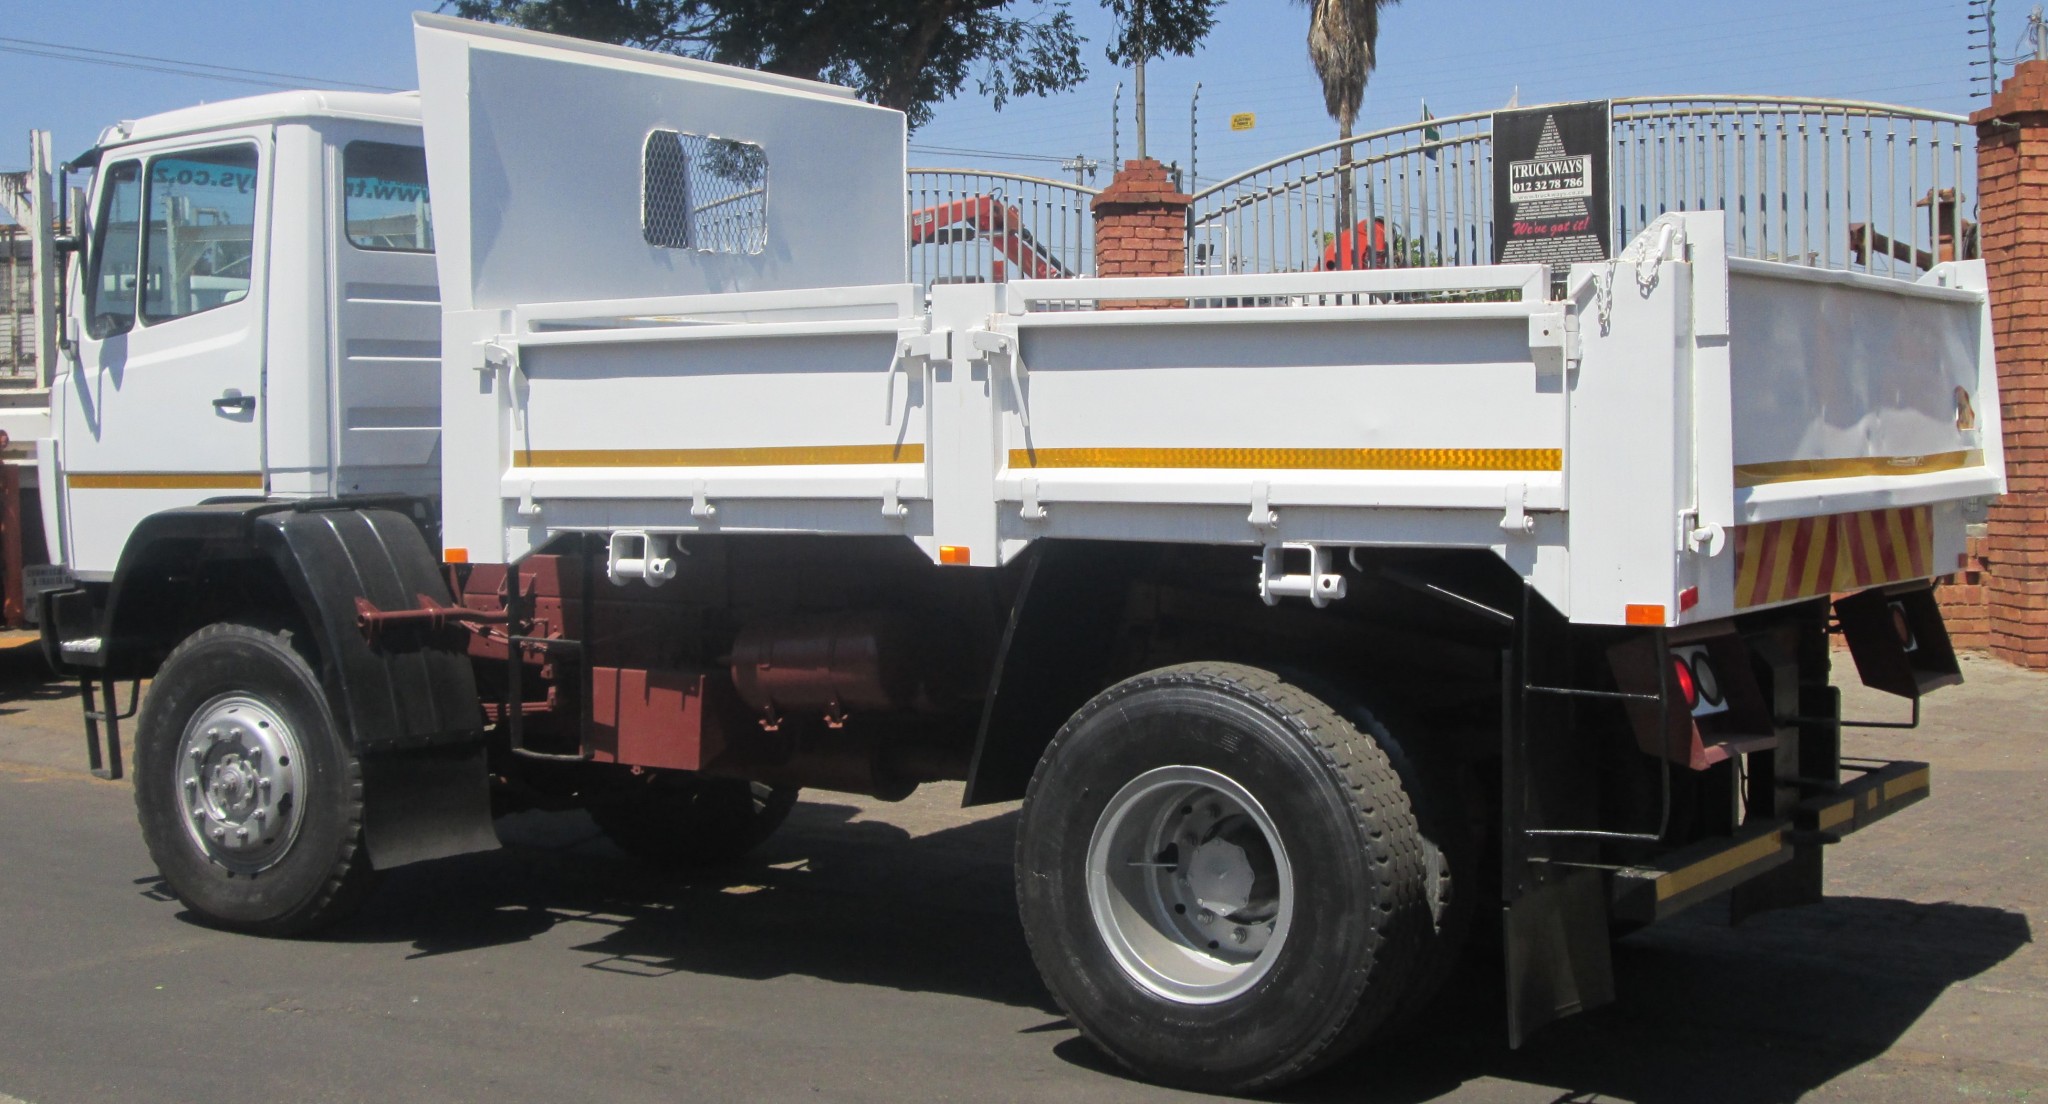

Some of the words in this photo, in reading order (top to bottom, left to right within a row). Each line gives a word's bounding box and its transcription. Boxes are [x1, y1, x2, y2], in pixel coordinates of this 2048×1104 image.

[1513, 160, 1583, 178] TRUCKWAYS
[1513, 181, 1532, 192] 012
[1534, 180, 1548, 191] 32
[1548, 179, 1561, 189] 78
[1563, 177, 1583, 188] 786
[1512, 220, 1548, 236] We've
[1550, 221, 1571, 237] got
[1573, 216, 1590, 231] it!
